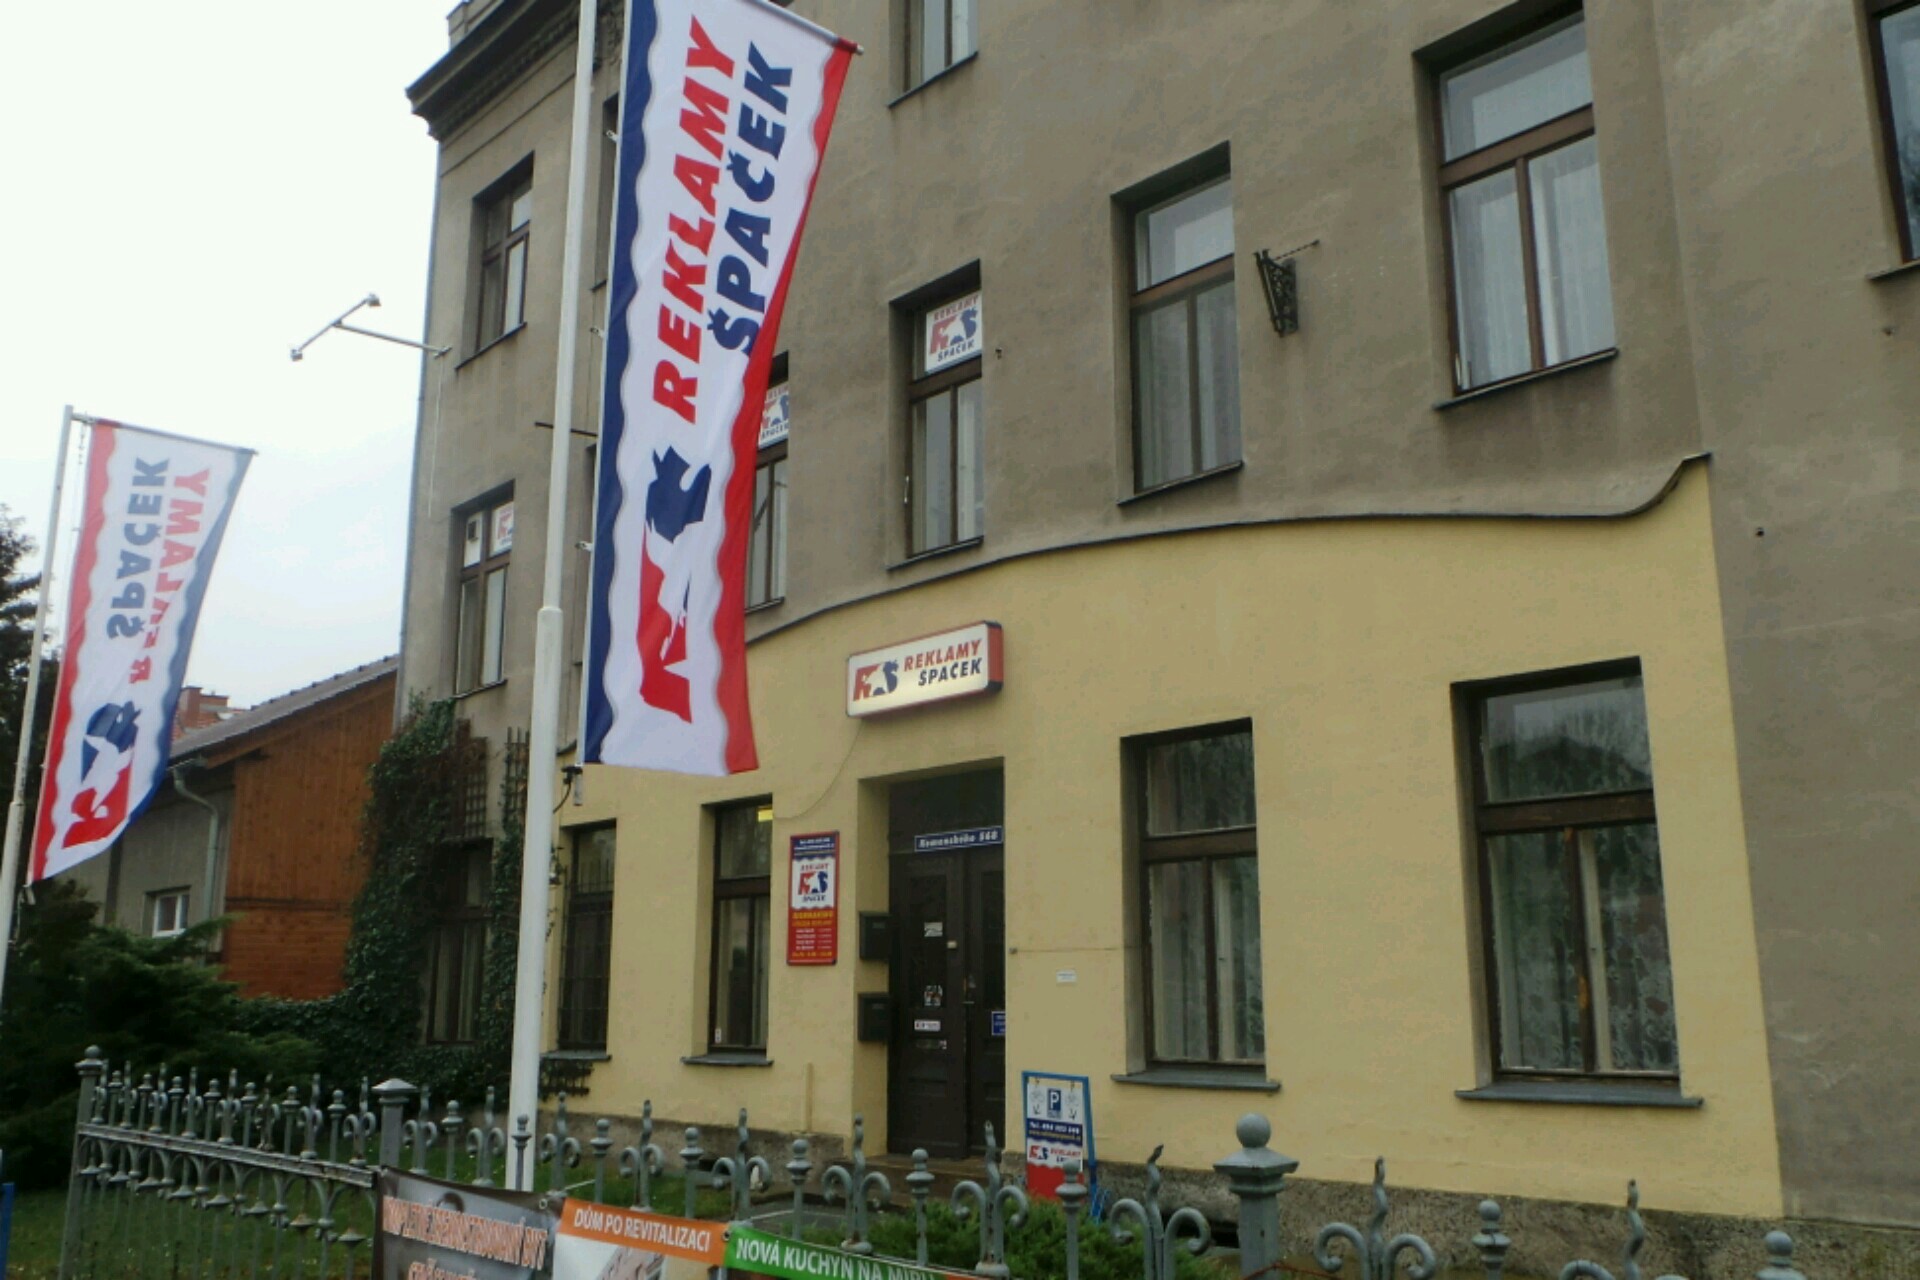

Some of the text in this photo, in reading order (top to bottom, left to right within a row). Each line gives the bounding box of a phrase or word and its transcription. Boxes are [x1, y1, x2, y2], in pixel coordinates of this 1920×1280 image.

[653, 14, 735, 425] REKLAMY
[706, 41, 793, 357] ŠPAČEK
[903, 638, 982, 672] REKLAMY
[605, 1214, 623, 1236] PO
[624, 1216, 711, 1253] REVITALIZACI
[736, 1237, 779, 1263] NOVÁ
[857, 1259, 883, 1280] NA
